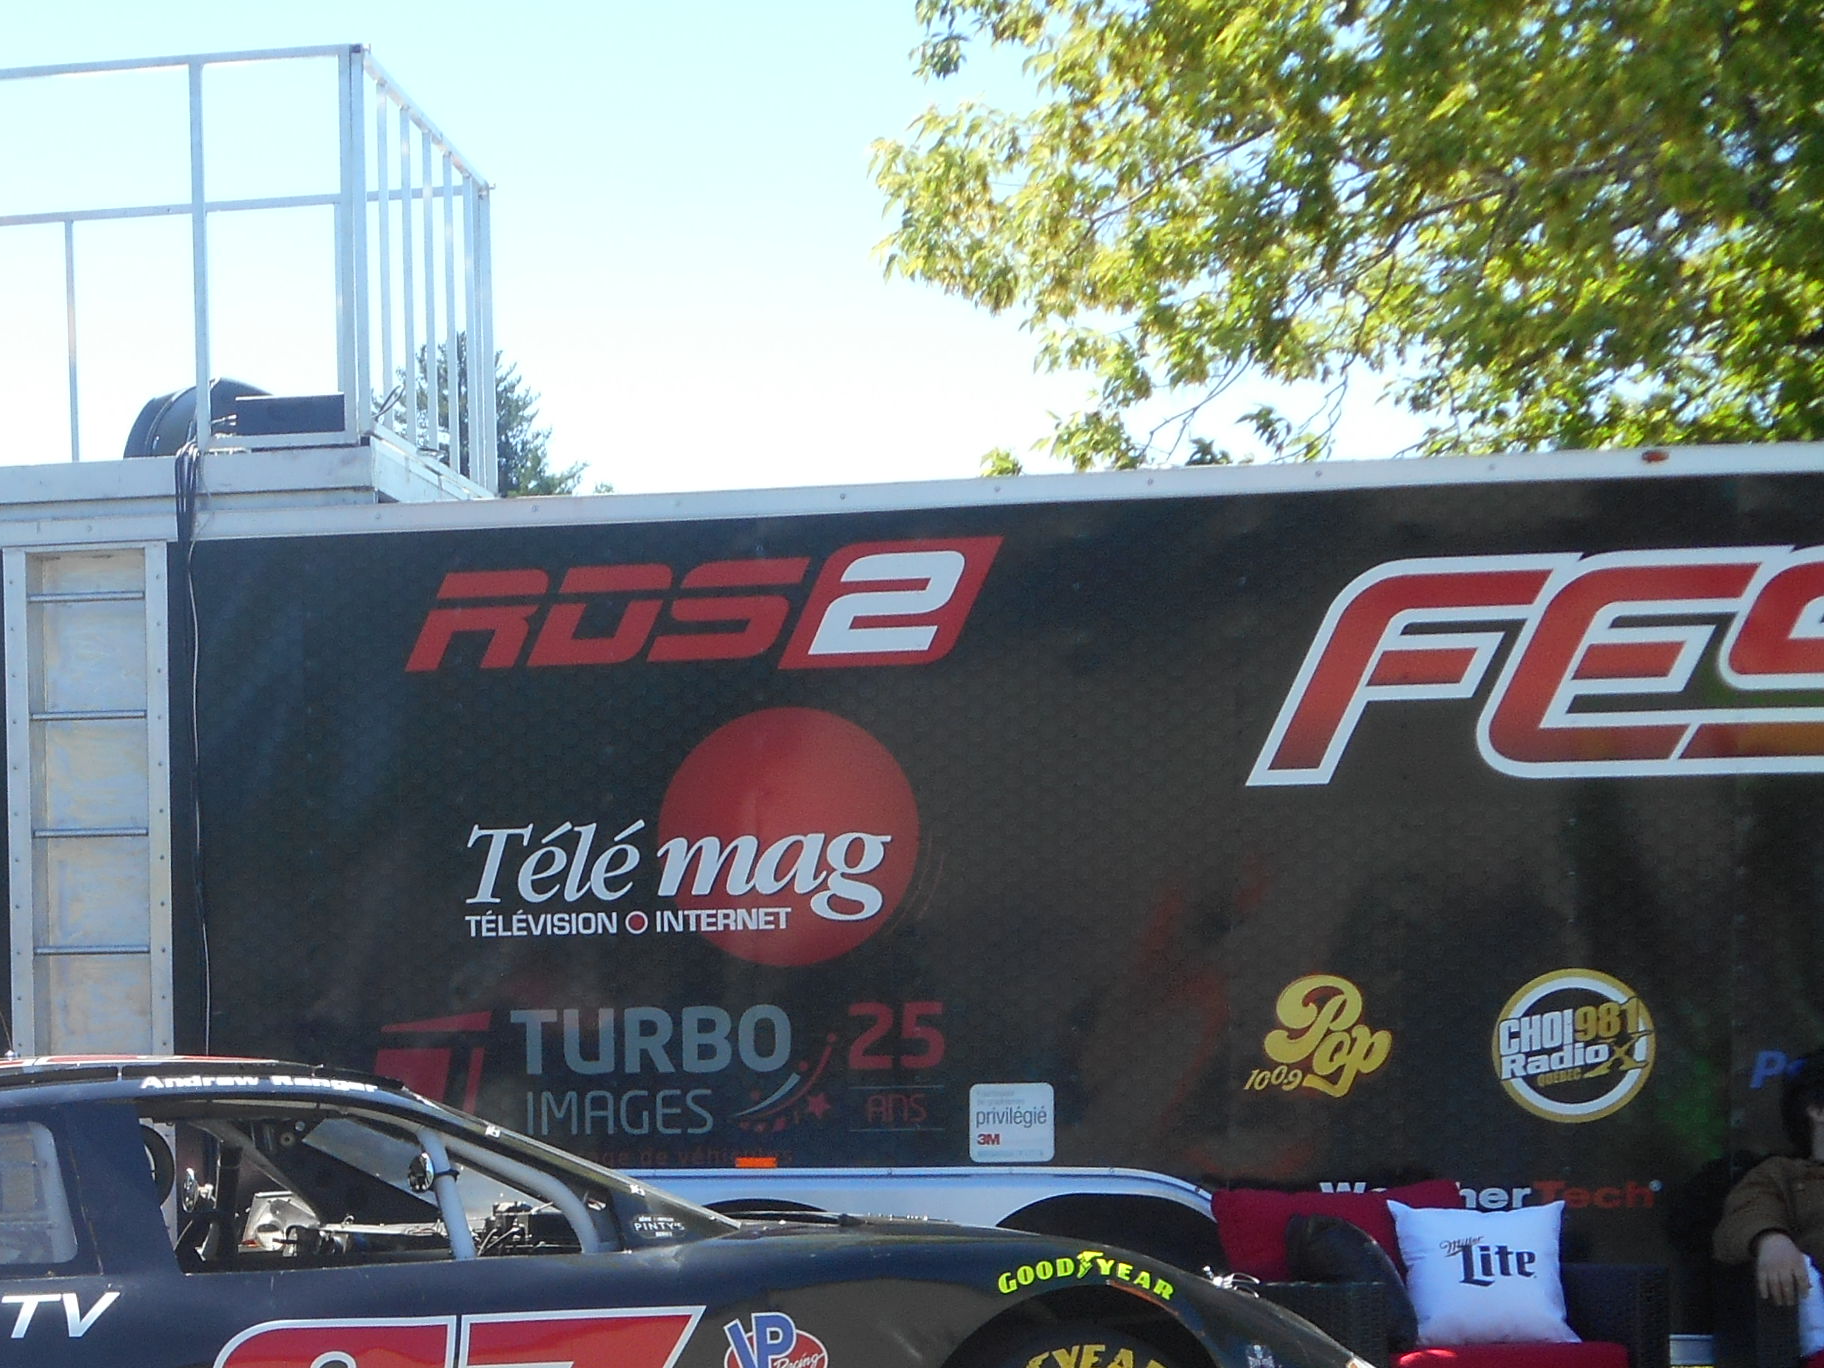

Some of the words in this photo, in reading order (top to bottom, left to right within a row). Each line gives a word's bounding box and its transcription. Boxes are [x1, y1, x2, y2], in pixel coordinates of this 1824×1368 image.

[465, 909, 618, 938] TÉLÉVISION
[655, 907, 792, 934] INTERNET
[510, 1003, 792, 1076] TURBO
[847, 1001, 945, 1070] 25
[1264, 974, 1393, 1098] Pop
[1501, 1041, 1610, 1081] Radio
[140, 1075, 259, 1090] Andrew
[269, 1075, 378, 1093] Ranger
[526, 1088, 715, 1136] IMAGES
[976, 1105, 1048, 1128] privilégié
[977, 1133, 1000, 1146] 3M
[1459, 1245, 1538, 1287] Lite
